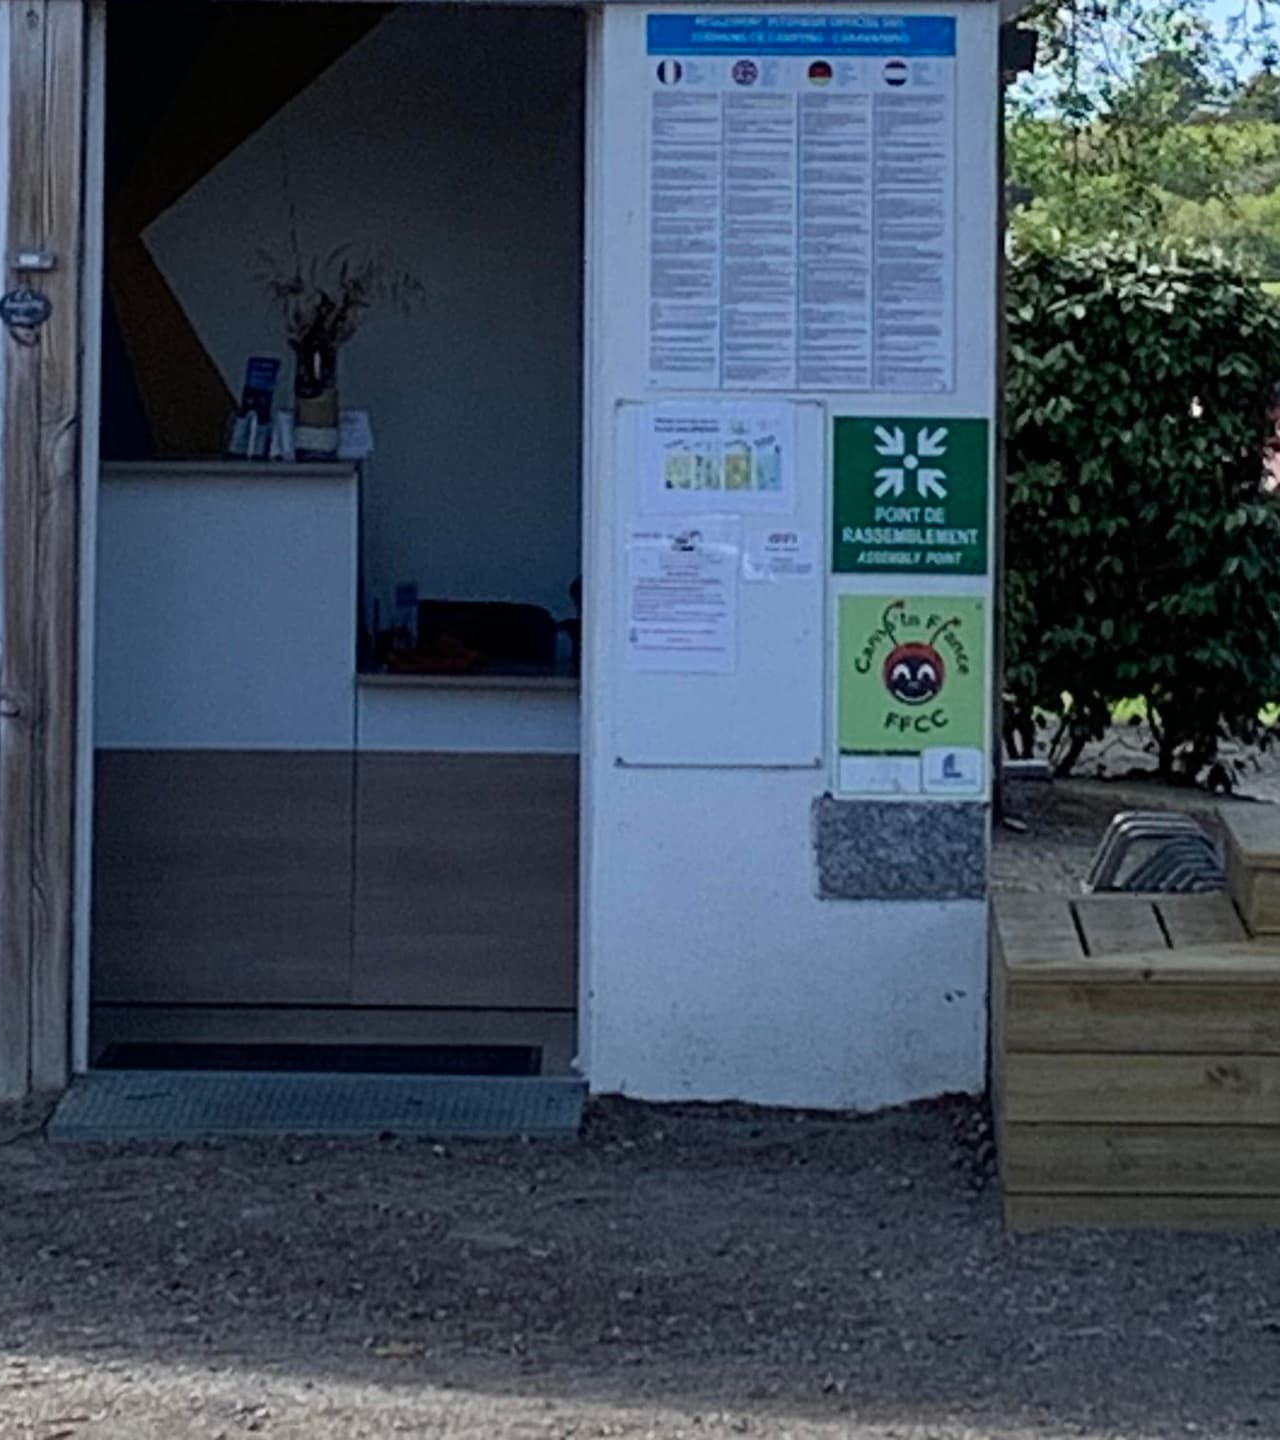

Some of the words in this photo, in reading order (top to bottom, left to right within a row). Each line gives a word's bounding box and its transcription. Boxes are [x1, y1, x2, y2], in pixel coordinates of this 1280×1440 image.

[874, 506, 921, 523] POINT
[924, 507, 945, 524] DE
[842, 526, 979, 545] RASSEMBLEMENT
[857, 550, 921, 565] ASSEMBLY
[924, 551, 963, 566] POINT
[883, 708, 949, 733] FFCC
